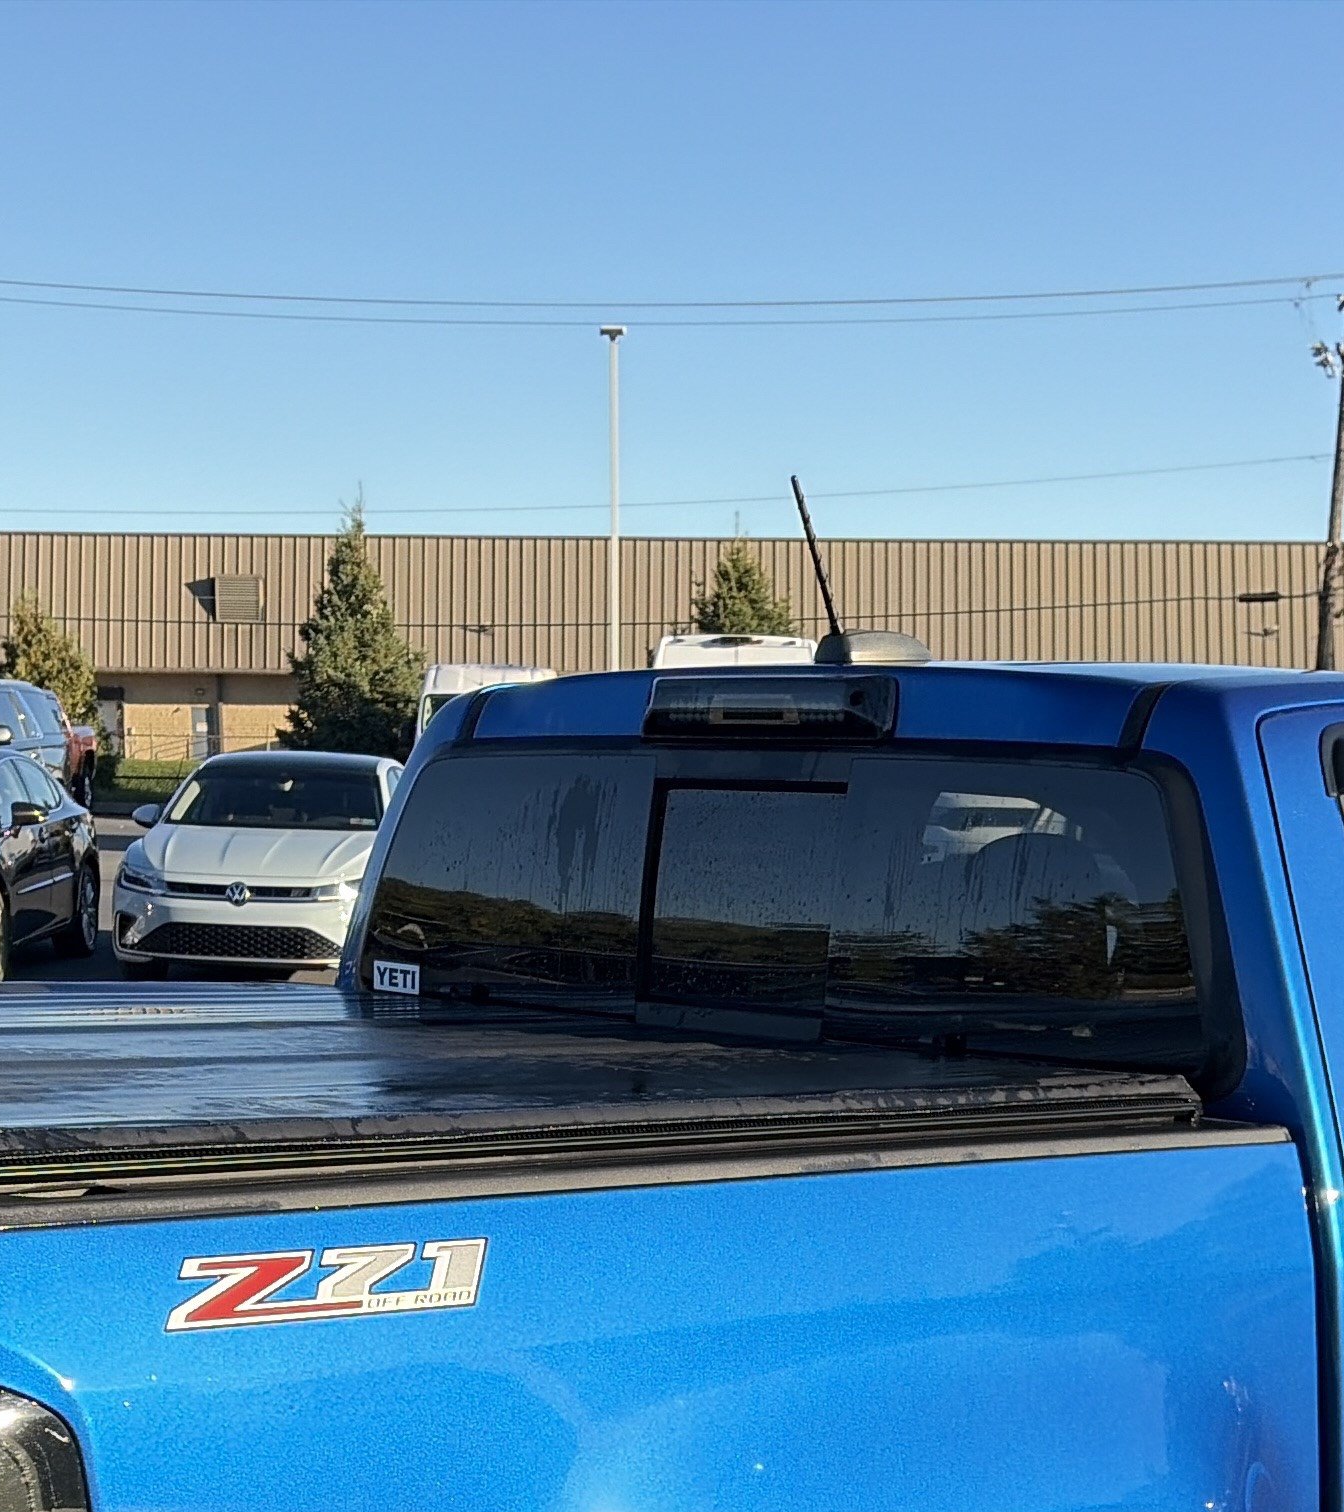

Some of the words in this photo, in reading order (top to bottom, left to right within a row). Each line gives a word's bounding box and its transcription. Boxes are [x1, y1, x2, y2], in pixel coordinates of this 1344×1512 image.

[376, 965, 416, 990] YETI
[165, 1238, 488, 1332] Z71
[367, 1295, 406, 1309] OFF
[414, 1290, 472, 1305] ROAD
